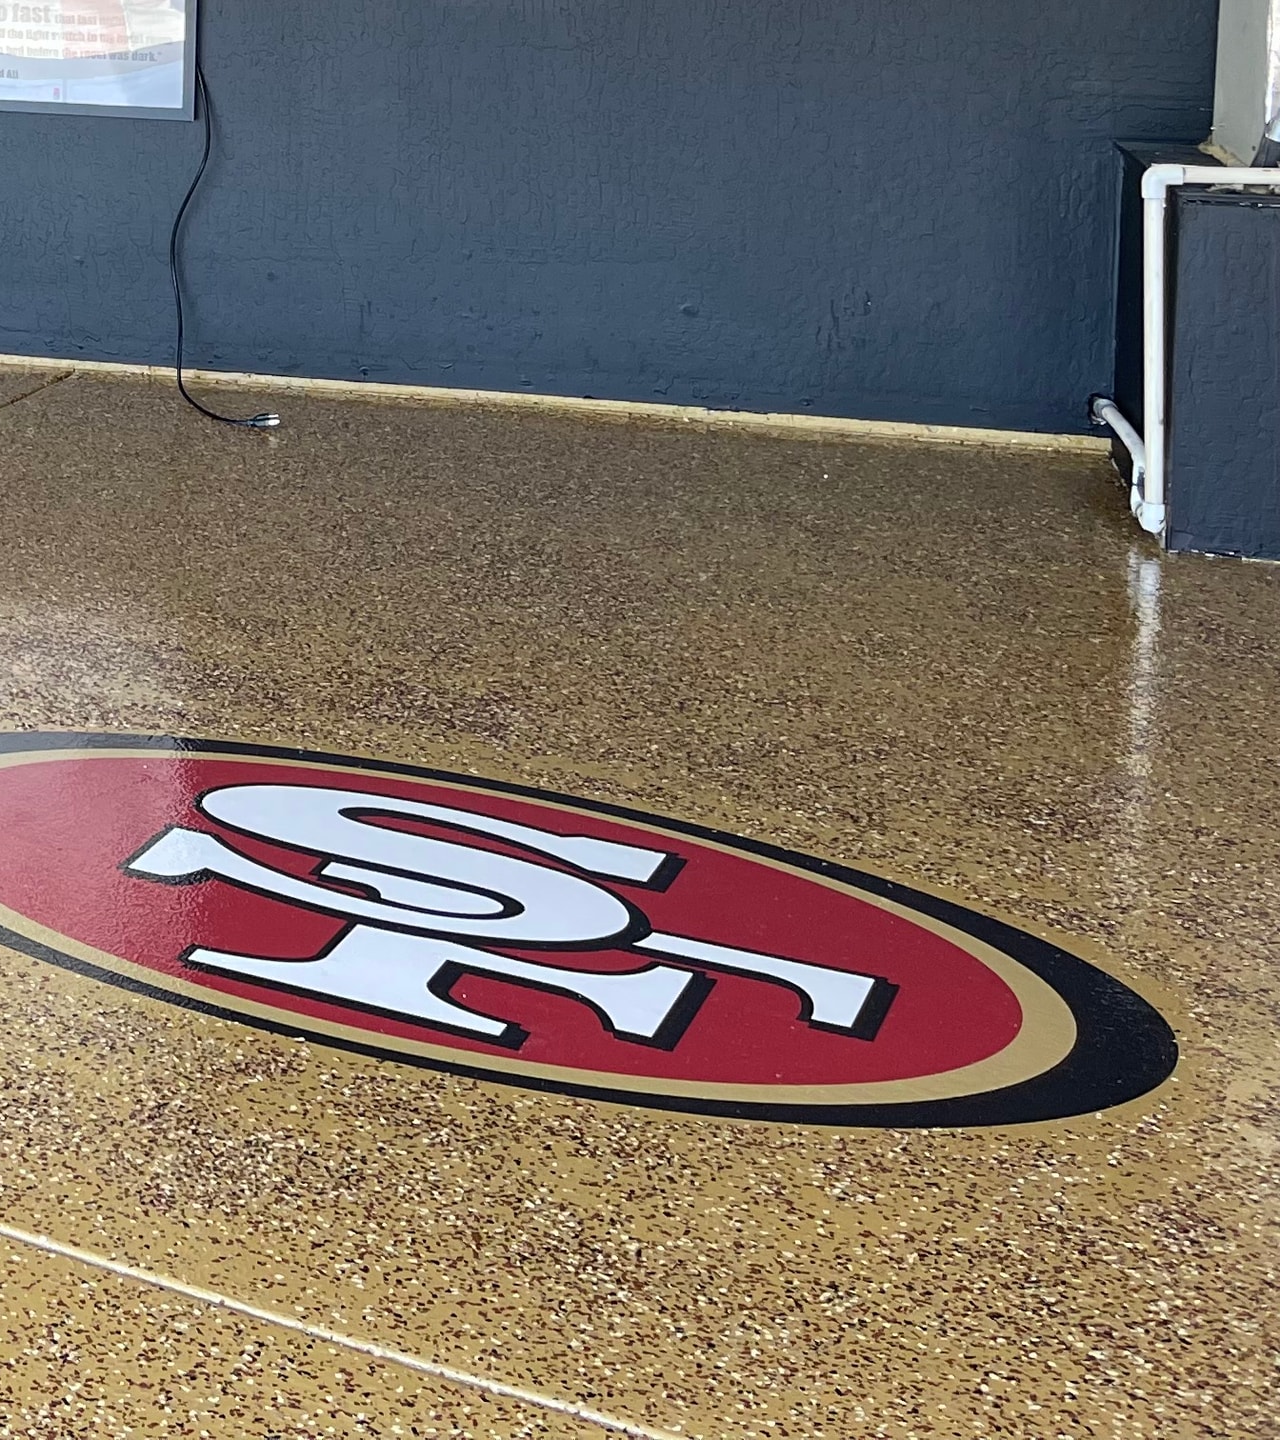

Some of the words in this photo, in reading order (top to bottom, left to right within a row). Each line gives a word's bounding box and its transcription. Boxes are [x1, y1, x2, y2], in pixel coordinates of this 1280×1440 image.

[12, 3, 51, 23] fast
[54, 14, 75, 24] that
[77, 15, 97, 25] last
[7, 28, 23, 39] the
[26, 29, 49, 41] light
[108, 50, 129, 60] was
[6, 68, 19, 79] Ali
